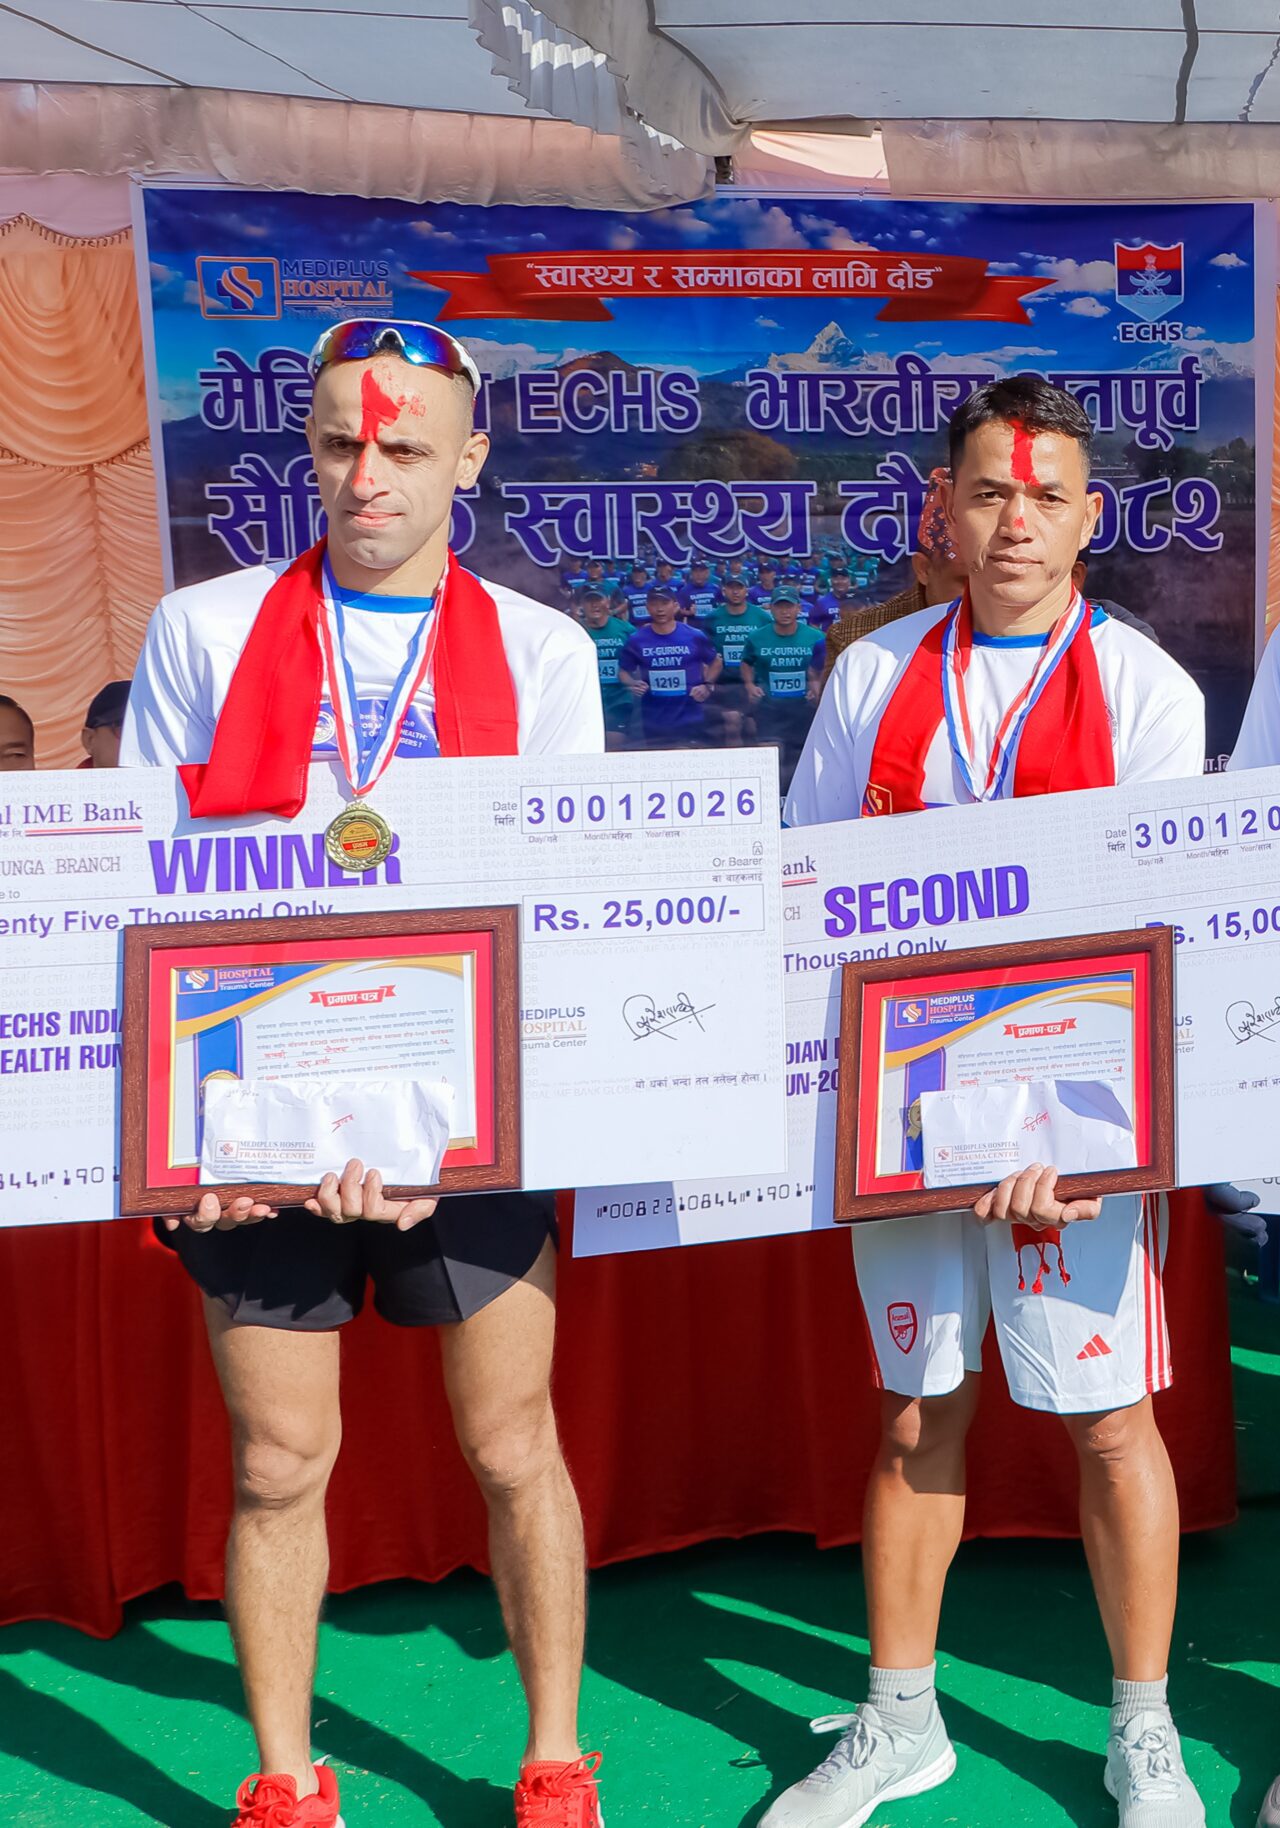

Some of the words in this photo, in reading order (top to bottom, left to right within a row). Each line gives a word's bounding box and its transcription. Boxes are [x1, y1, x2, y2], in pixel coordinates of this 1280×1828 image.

[282, 259, 389, 277] MEDIPLUS
[643, 266, 664, 288] र
[671, 266, 803, 288] सम्मानका
[811, 261, 879, 289] लागि
[282, 280, 393, 298] HOSPITAL
[1118, 322, 1182, 343] ECHS
[517, 370, 700, 435] ECHS
[504, 479, 817, 568] स्वास्थ्य
[642, 646, 690, 657] EX-GURKHA
[761, 647, 812, 656] EX-GURKHA
[651, 657, 683, 667] ARMY
[770, 657, 803, 667] ARMY
[655, 677, 680, 689] 1219
[774, 678, 801, 689] 1750
[492, 800, 518, 811] Date
[23, 803, 74, 825] IME
[83, 801, 143, 822] Bank
[494, 813, 516, 827] मिति
[1105, 828, 1127, 840] Date
[55, 856, 121, 874] BRANCH
[712, 857, 727, 868] Or
[728, 855, 763, 867] Bearer
[782, 855, 817, 876] ank
[823, 865, 1030, 938] SECOND
[64, 909, 120, 932] Five
[129, 903, 268, 928] Thousand
[272, 899, 335, 917] Only
[534, 903, 590, 932] Rs.
[603, 895, 741, 932] 25,000/-
[783, 942, 889, 972] Thousand
[896, 936, 948, 957] Only
[219, 968, 274, 981] HOSPITAL
[219, 983, 249, 991] Trauma
[249, 980, 275, 989] Center
[325, 991, 379, 1007] प्रमाण-पत्र
[930, 995, 975, 1005] MEDIPLUS
[929, 1003, 976, 1013] HOSPITAL
[0, 1011, 61, 1039] ECHS
[929, 1017, 953, 1025] Trauma
[953, 1014, 976, 1023] Center
[523, 1020, 587, 1035] OSPITAL
[1017, 1023, 1062, 1037] प्रमाण-पत्र
[553, 1038, 587, 1049] Center
[0, 1046, 71, 1075] EALTH
